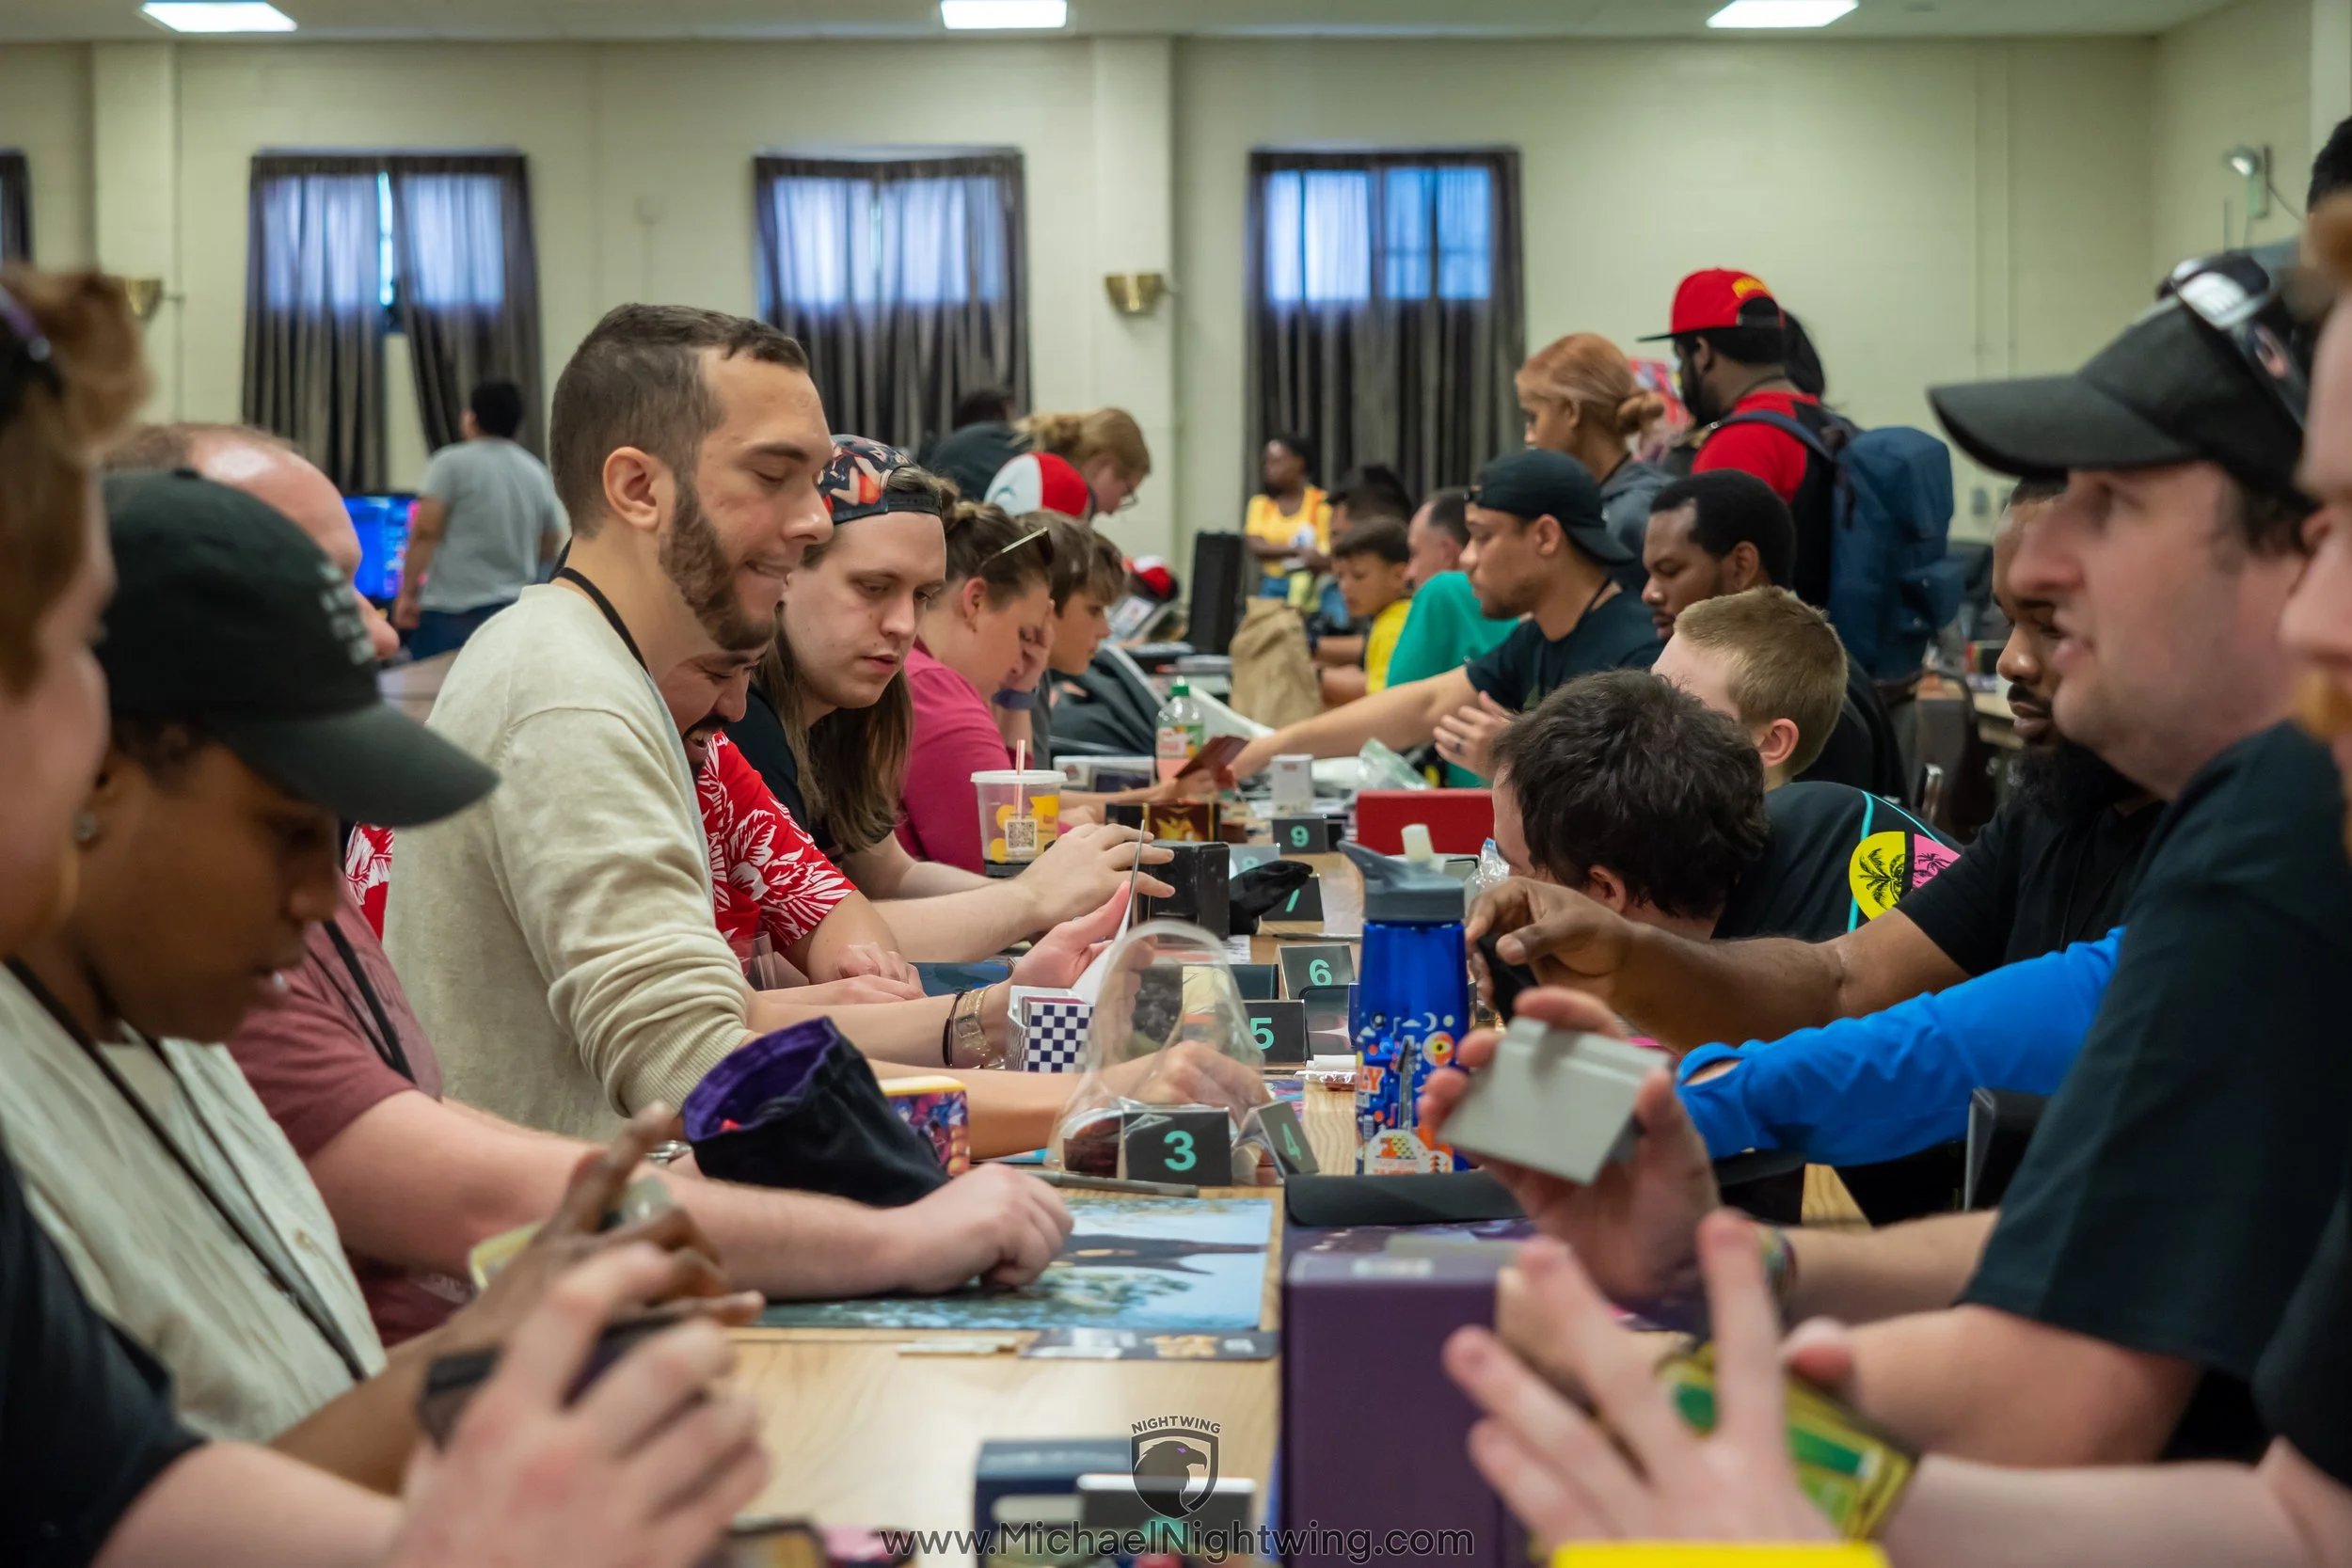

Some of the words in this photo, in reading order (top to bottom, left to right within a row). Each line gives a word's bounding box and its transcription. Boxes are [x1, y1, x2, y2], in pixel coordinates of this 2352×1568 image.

[1290, 825, 1311, 847] 9
[1309, 959, 1332, 986] 6
[1250, 1018, 1274, 1050] 5
[1164, 1131, 1197, 1171] 3
[1281, 1123, 1303, 1160] 4
